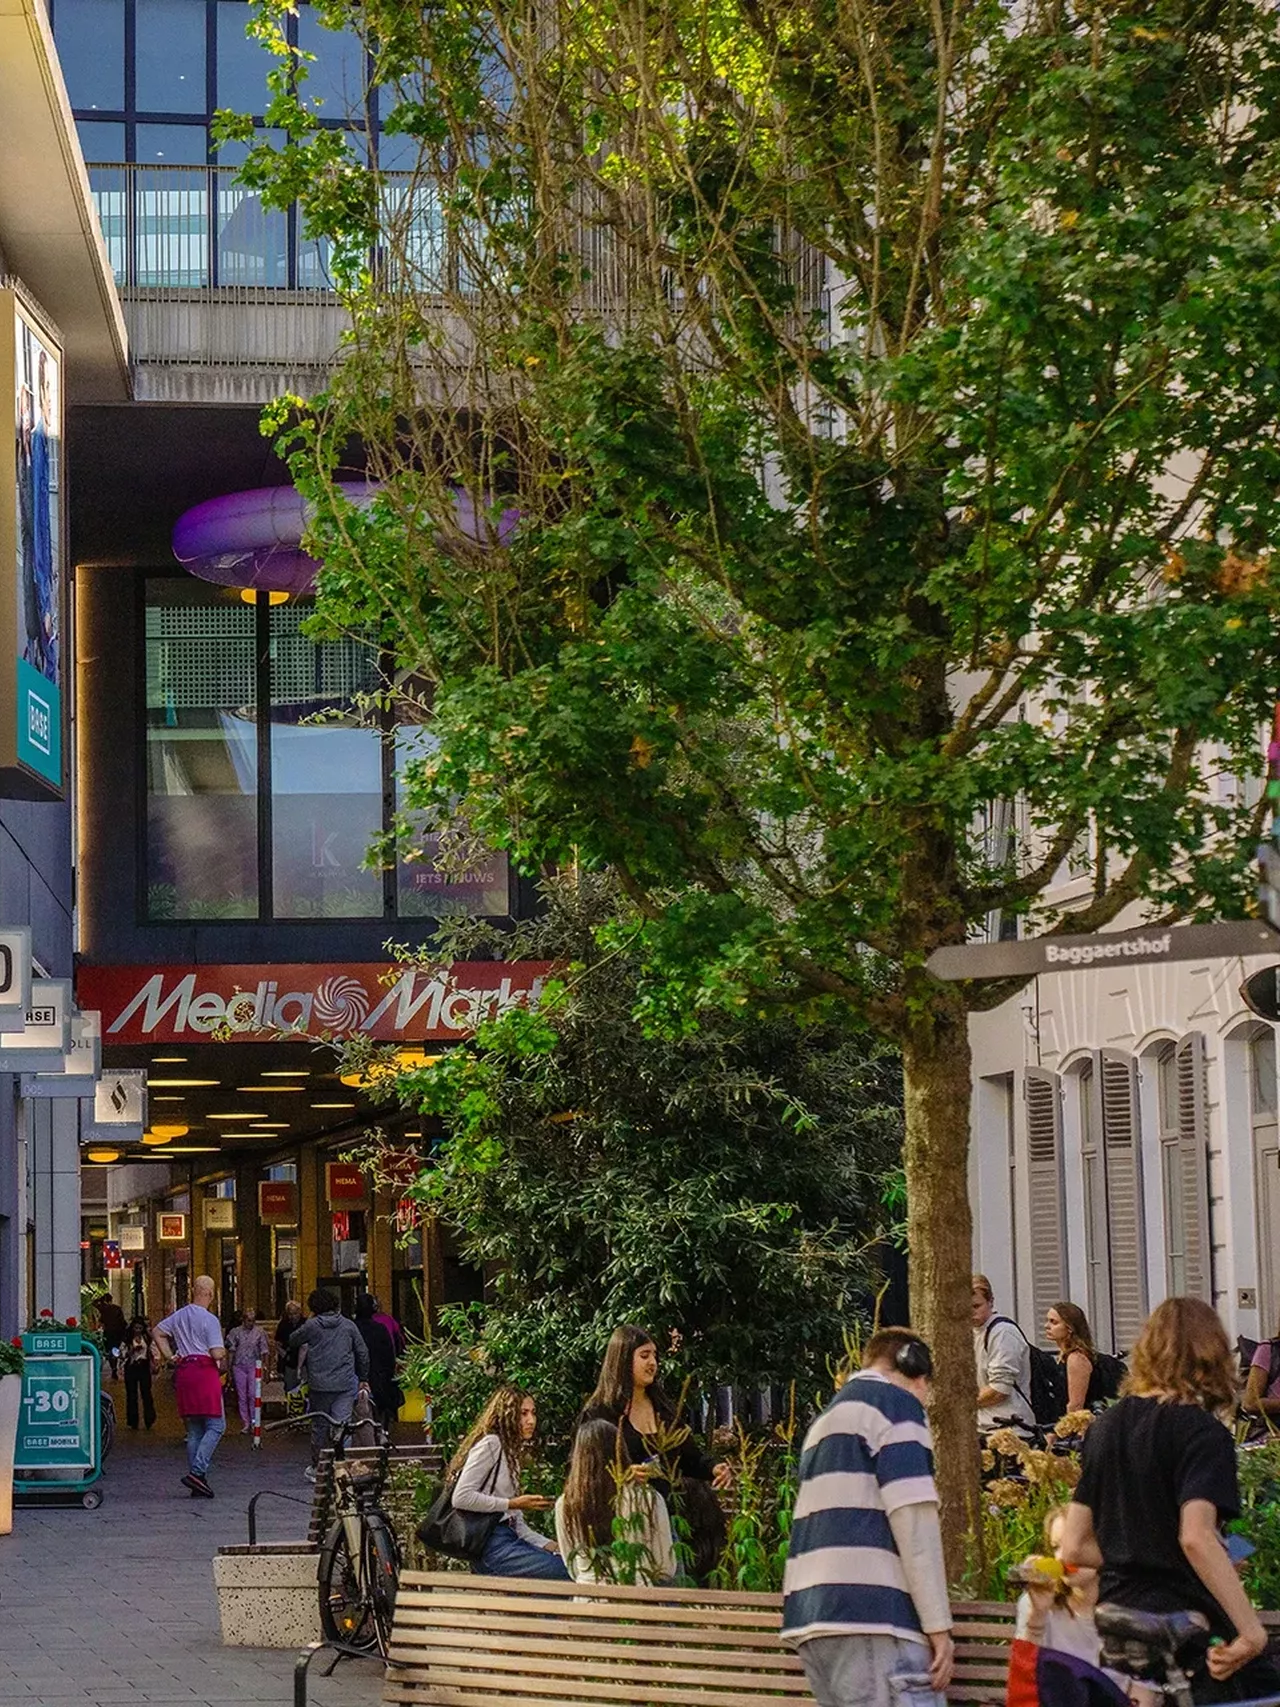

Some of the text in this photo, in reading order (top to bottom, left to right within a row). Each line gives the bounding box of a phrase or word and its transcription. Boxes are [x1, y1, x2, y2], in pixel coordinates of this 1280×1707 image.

[30, 704, 48, 741] BASE
[415, 873, 442, 884] IETS
[1045, 934, 1171, 964] Baggaertshof
[106, 973, 315, 1034] Media
[25, 1011, 51, 1022] ASE
[70, 1038, 92, 1049] OLL
[23, 1084, 43, 1095] 005
[335, 1177, 357, 1186] HEMA
[266, 1194, 286, 1202] HEMA
[36, 1340, 63, 1348] BASE
[23, 1388, 79, 1412] -30%
[26, 1438, 48, 1446] BASE
